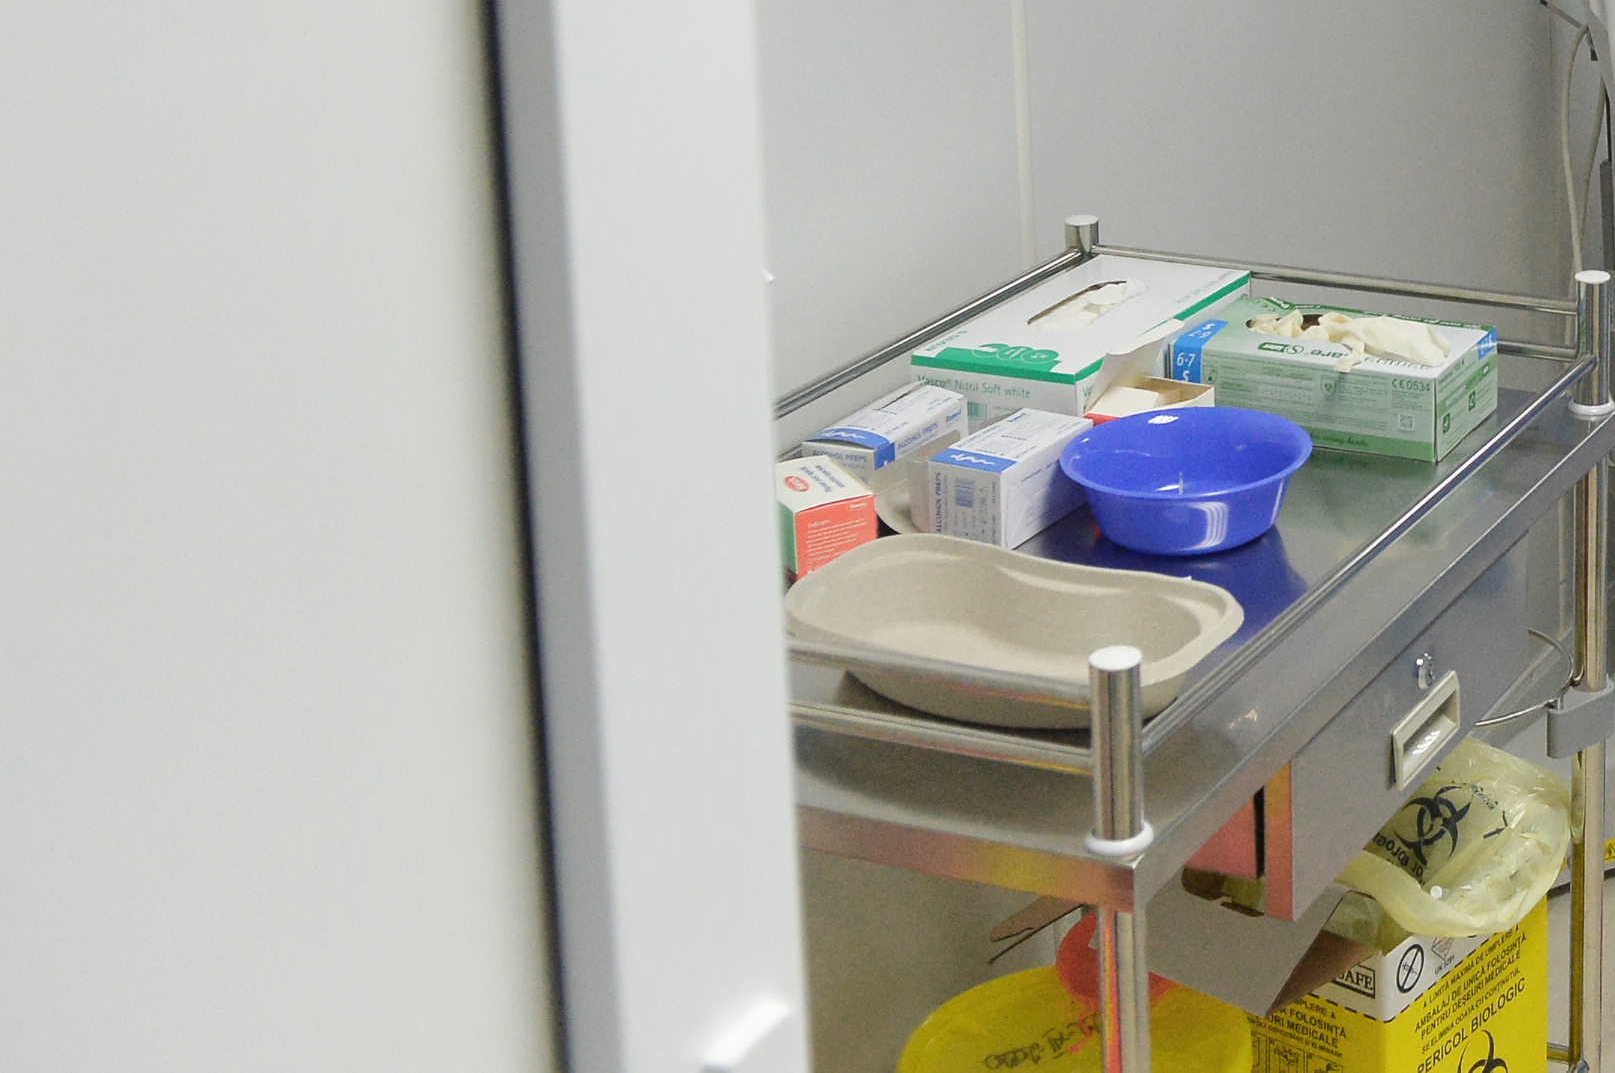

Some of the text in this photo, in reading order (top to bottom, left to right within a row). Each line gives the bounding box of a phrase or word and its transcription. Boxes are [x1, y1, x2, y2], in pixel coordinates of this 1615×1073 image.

[1176, 351, 1196, 368] 6-7
[954, 379, 978, 392] Nitril
[981, 381, 1001, 395] Soft
[1004, 385, 1031, 399] white
[1182, 370, 1190, 382] S
[935, 498, 943, 533] ALCOHOL
[1415, 996, 1449, 1032] AMBALAJ
[1452, 985, 1462, 1001] DE
[1421, 1009, 1451, 1039] PENTRU
[1485, 950, 1521, 984] MEDICALE
[1287, 1022, 1338, 1048] MEDICALE
[1418, 977, 1525, 1073] PERICOL BIOLOGIC
